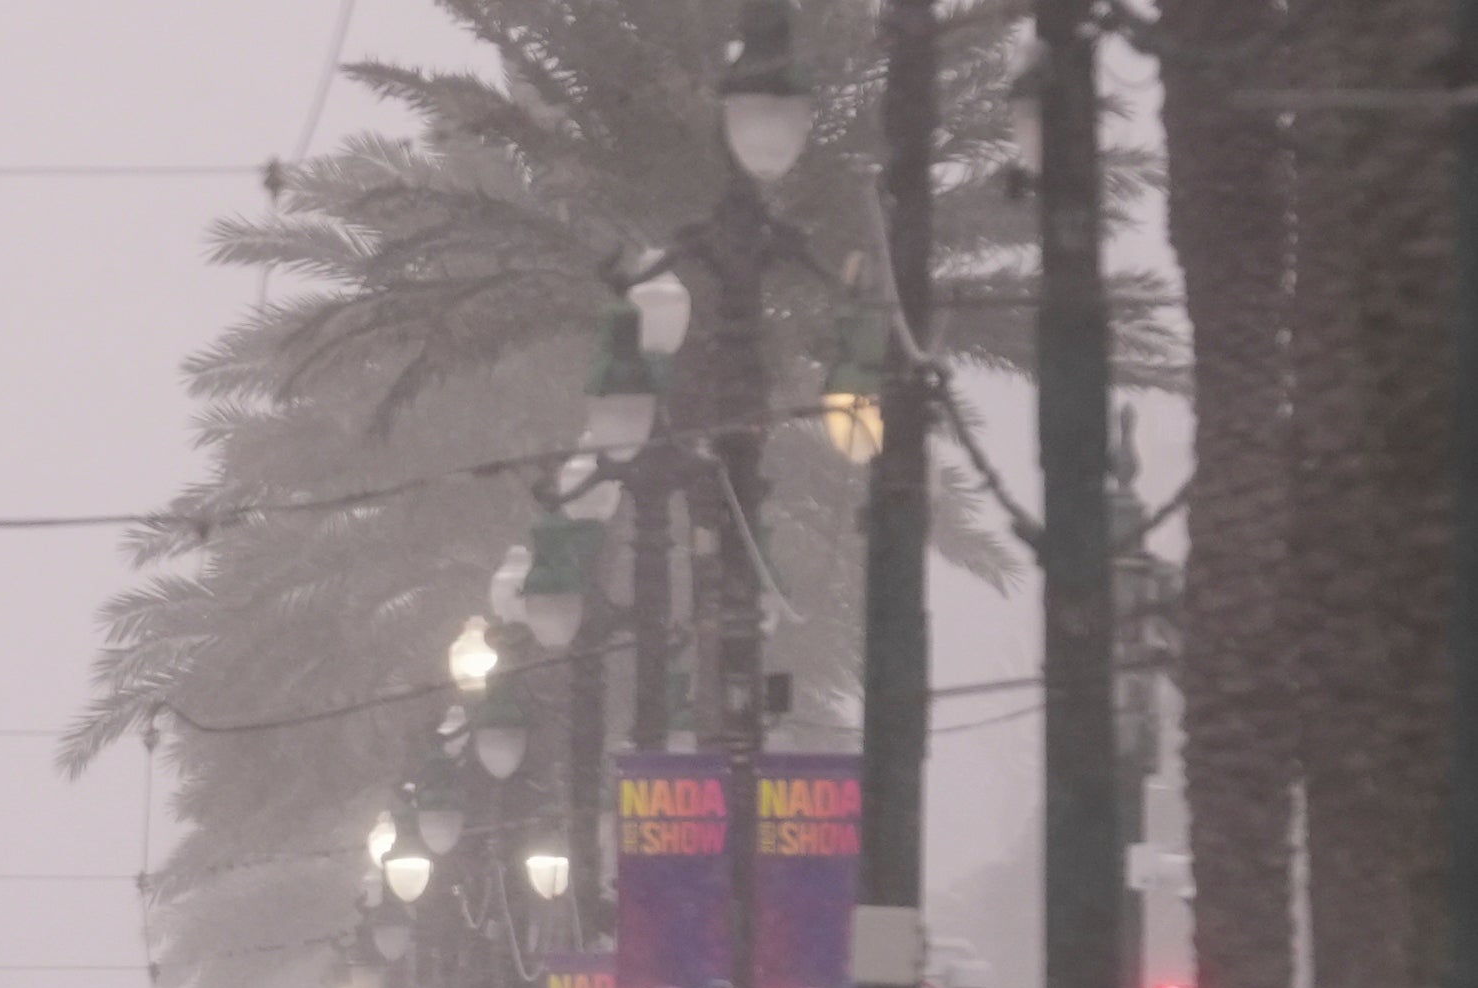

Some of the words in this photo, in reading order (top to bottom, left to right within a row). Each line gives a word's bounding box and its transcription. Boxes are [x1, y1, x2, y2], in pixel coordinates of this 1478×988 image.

[621, 778, 728, 818] NADA
[758, 778, 862, 818] NADA
[640, 821, 729, 855] SHOW
[776, 821, 862, 856] SHOW
